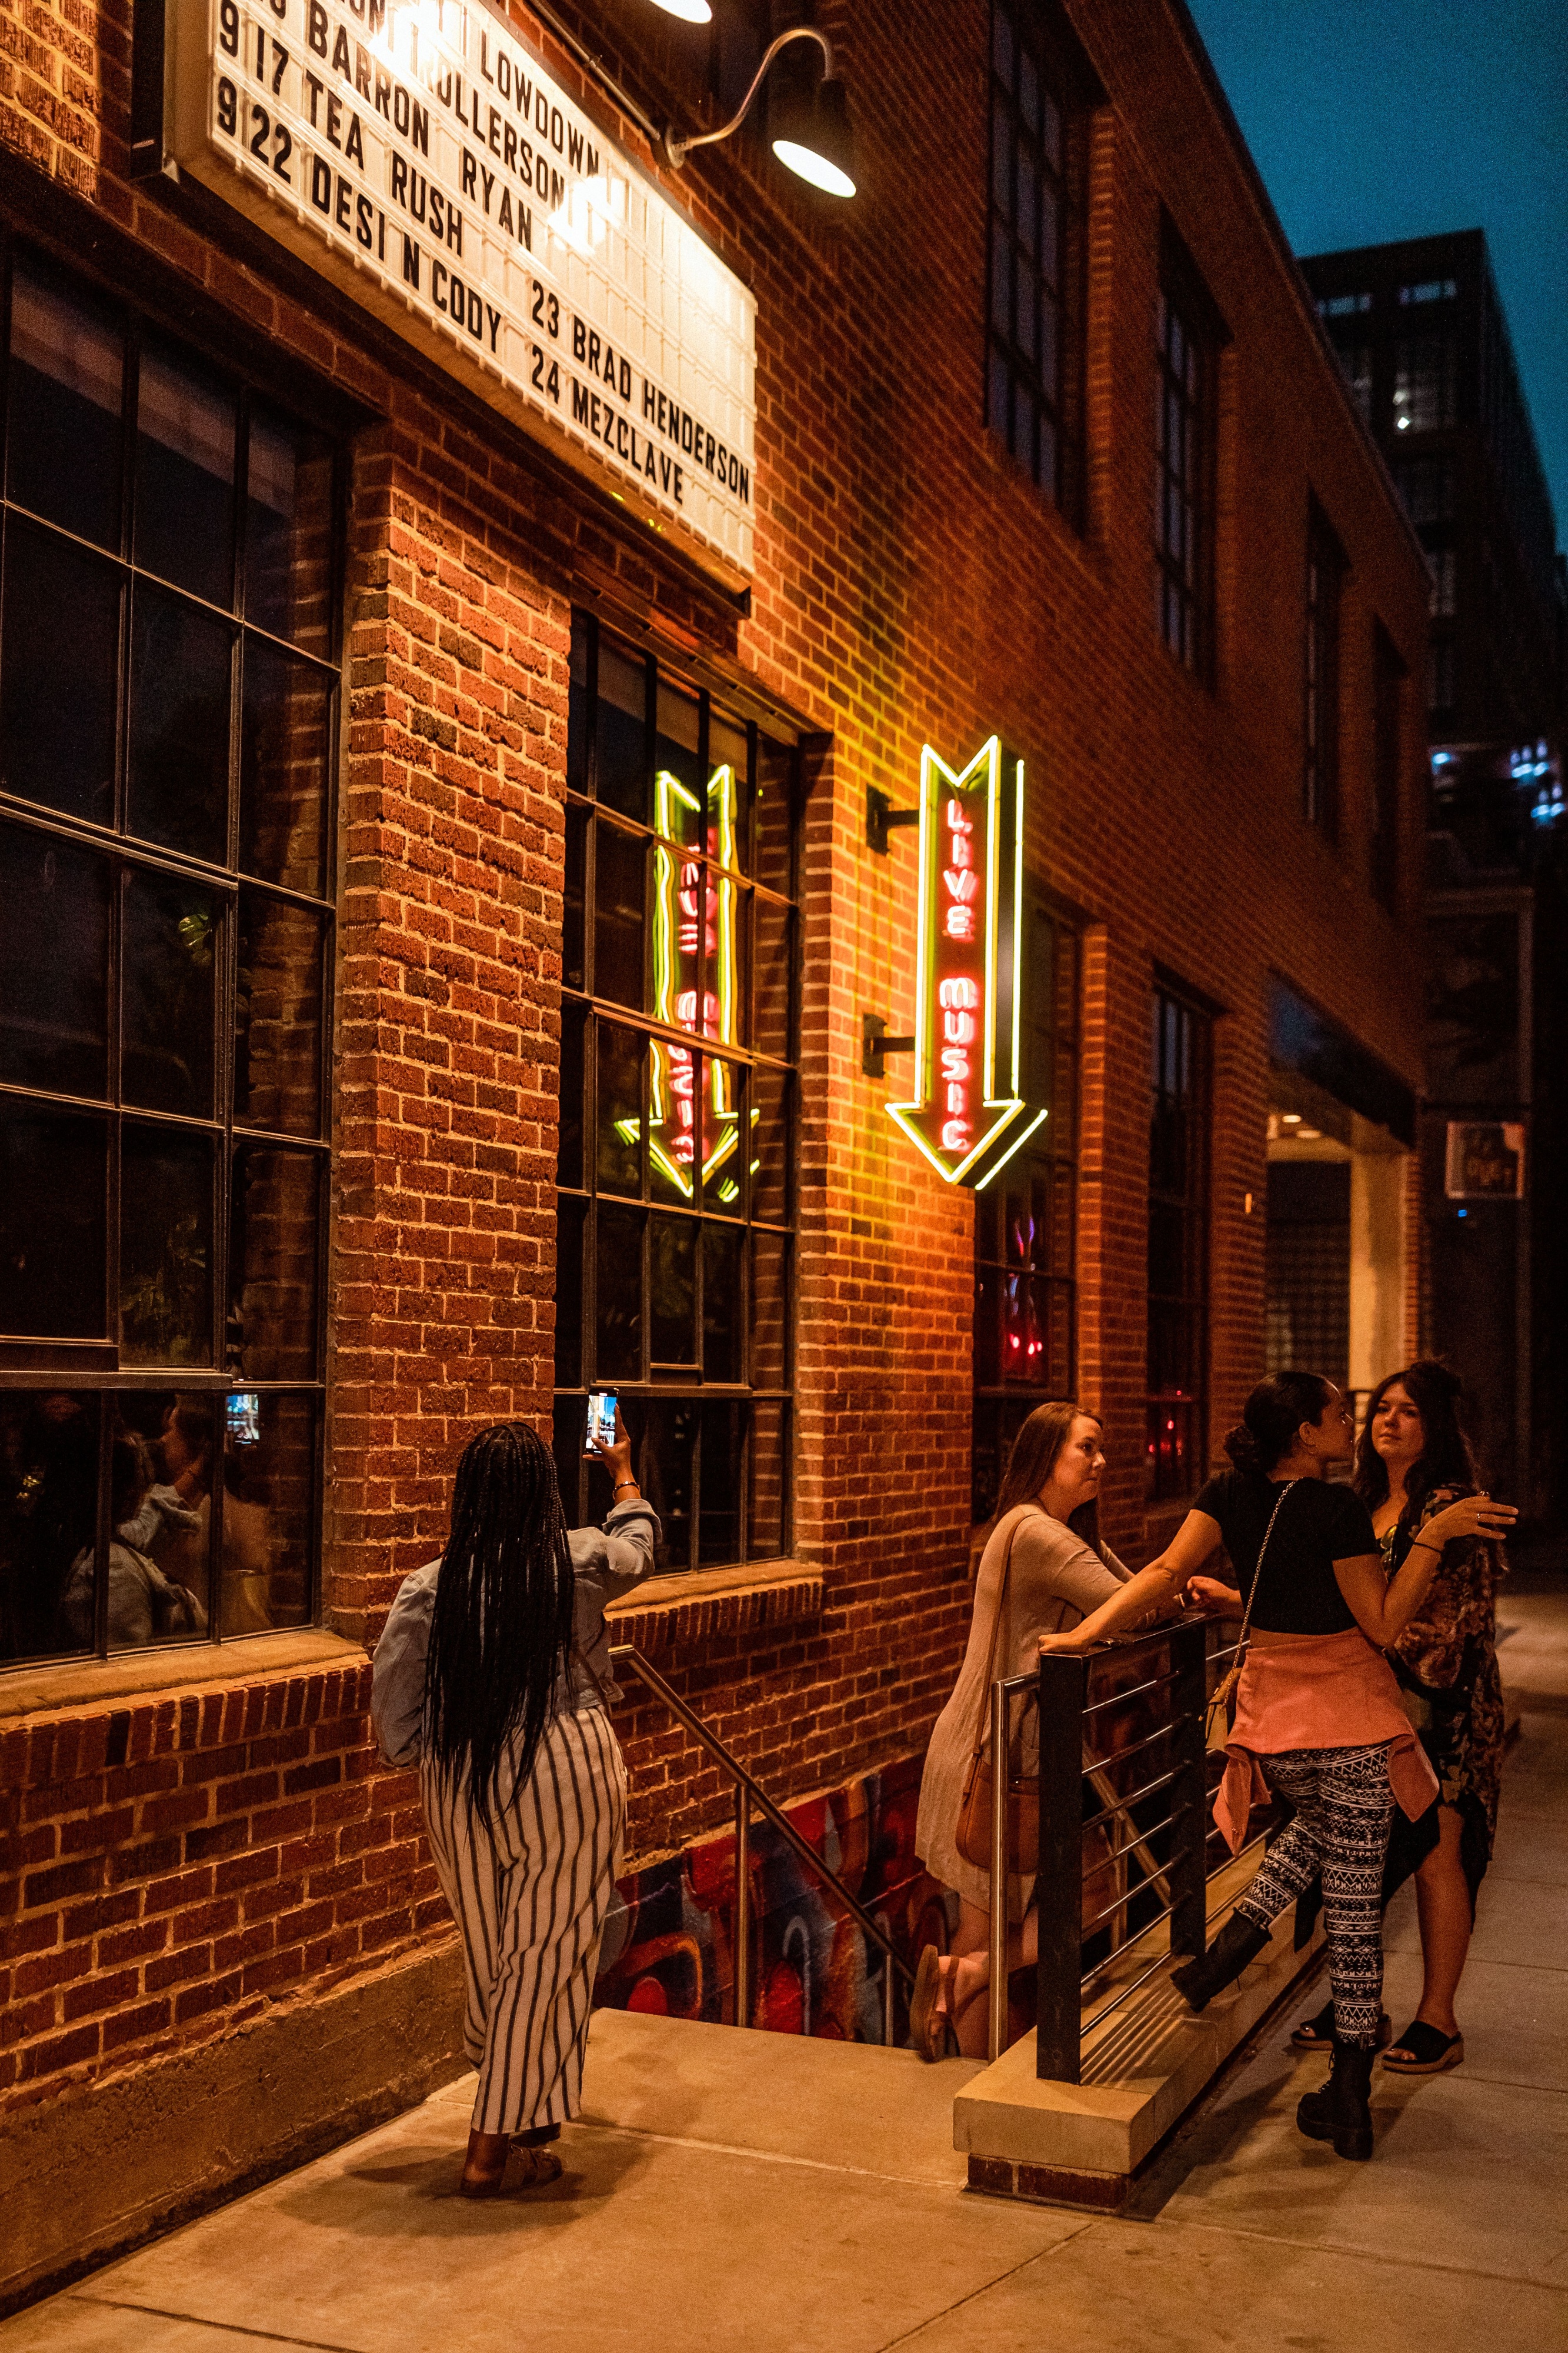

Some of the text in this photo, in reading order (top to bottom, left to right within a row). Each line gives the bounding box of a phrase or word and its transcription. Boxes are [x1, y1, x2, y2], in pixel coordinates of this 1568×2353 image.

[218, 76, 236, 137] 9
[251, 104, 292, 184] 22
[433, 259, 501, 353] CODY
[220, 0, 239, 57] 9
[256, 25, 289, 96] 17
[306, 69, 364, 171] TEA
[392, 150, 462, 258] RUSH
[309, 0, 531, 253] BARRON RYAN
[481, 29, 599, 175] LOWDOWN
[532, 280, 749, 504] 23 BRAD HENDERSON
[532, 345, 683, 505] 24 MEZCLAVE
[939, 799, 973, 1151] LIVE MUSIC
